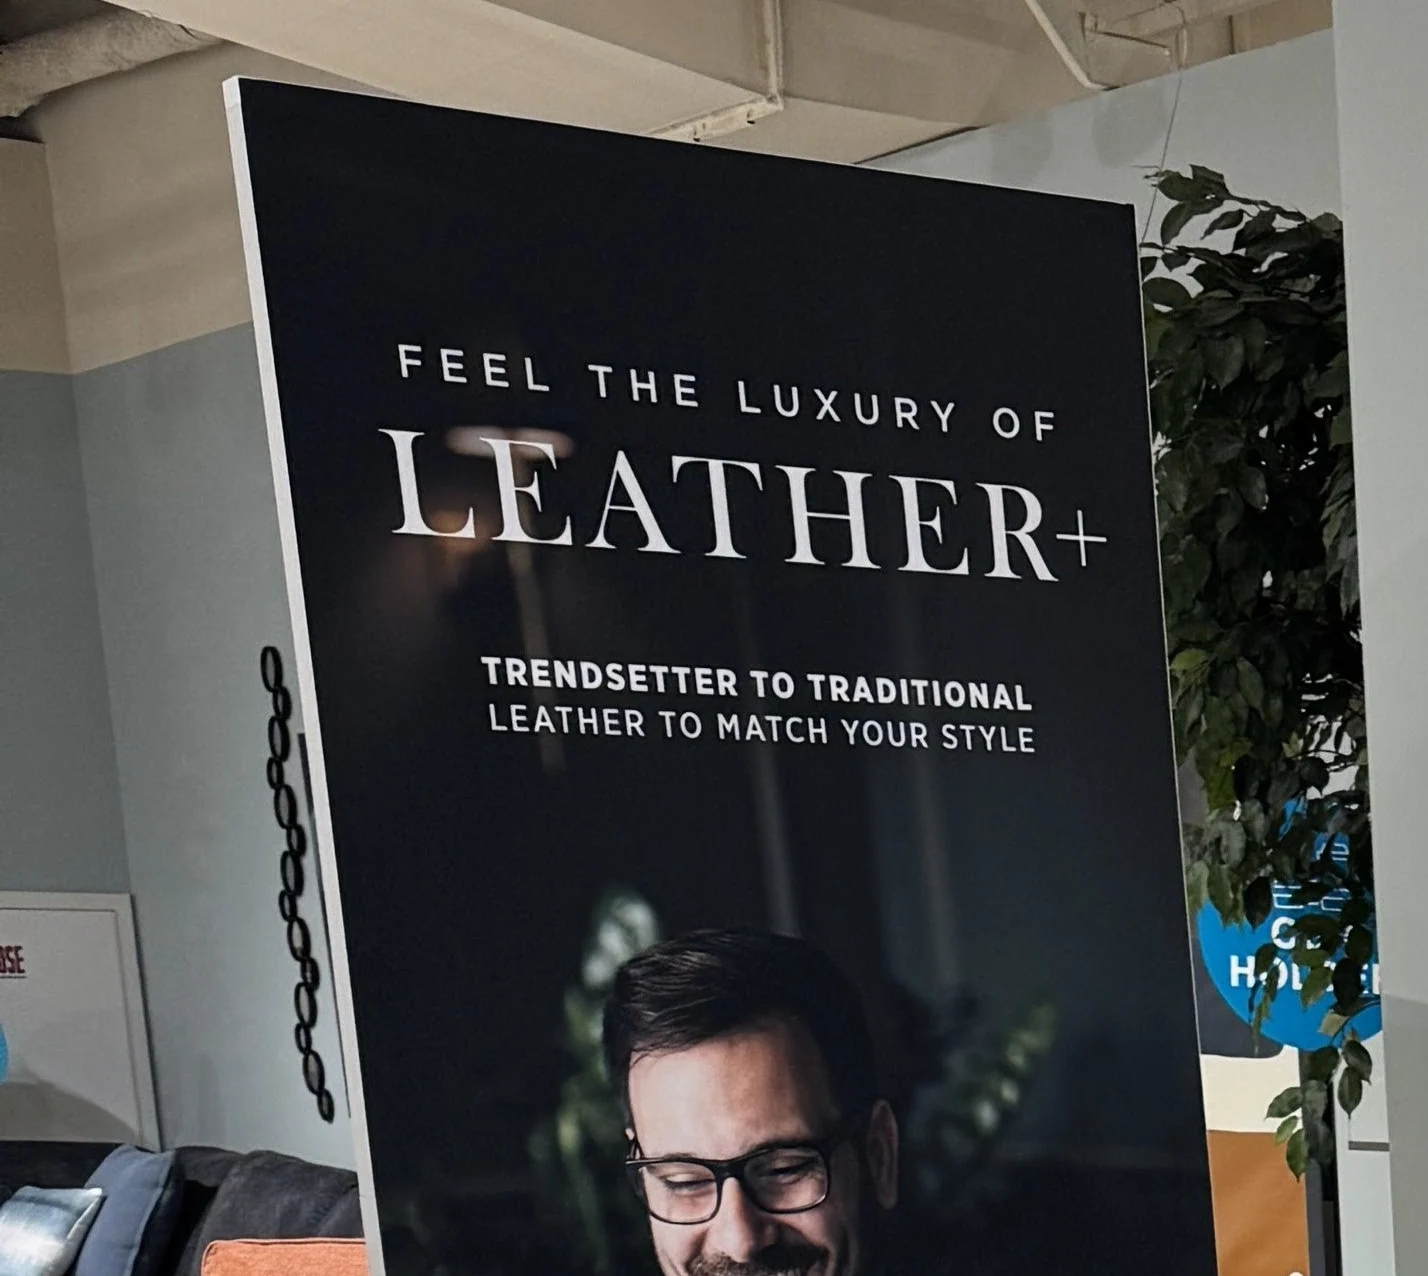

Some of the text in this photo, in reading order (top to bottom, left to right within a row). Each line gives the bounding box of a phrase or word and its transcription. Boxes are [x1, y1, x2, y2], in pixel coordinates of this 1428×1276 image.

[398, 344, 1057, 441] FEEL THE LUXURY OF
[378, 428, 1107, 582] LEATHER+
[480, 656, 1033, 711] TRENDSETTER TO TRADITIONAL
[489, 703, 1035, 753] LEATHER TO MATCH YOUR STYLE
